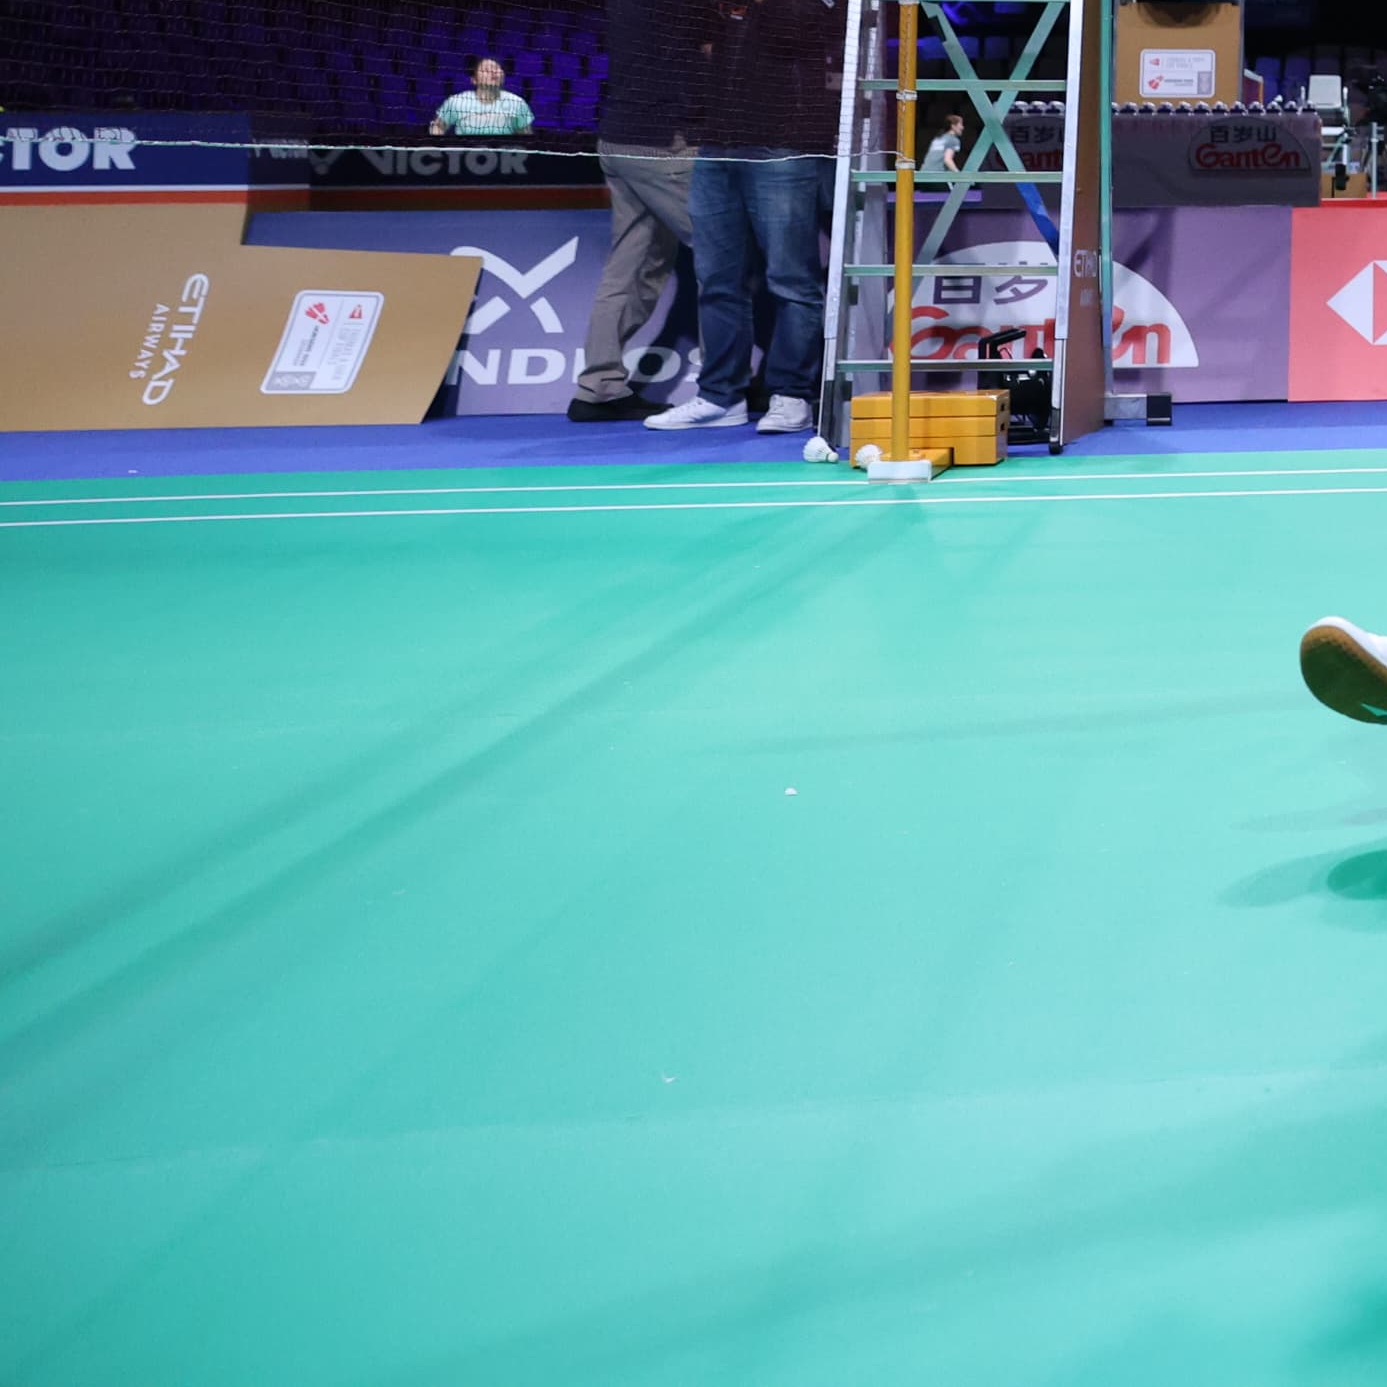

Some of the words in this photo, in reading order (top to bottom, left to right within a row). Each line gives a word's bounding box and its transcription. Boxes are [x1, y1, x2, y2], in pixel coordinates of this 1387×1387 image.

[0, 127, 136, 171] TOR
[1210, 125, 1277, 143] 百岁山
[128, 302, 171, 380] AIRWAYS
[142, 273, 210, 406] ETIHAD
